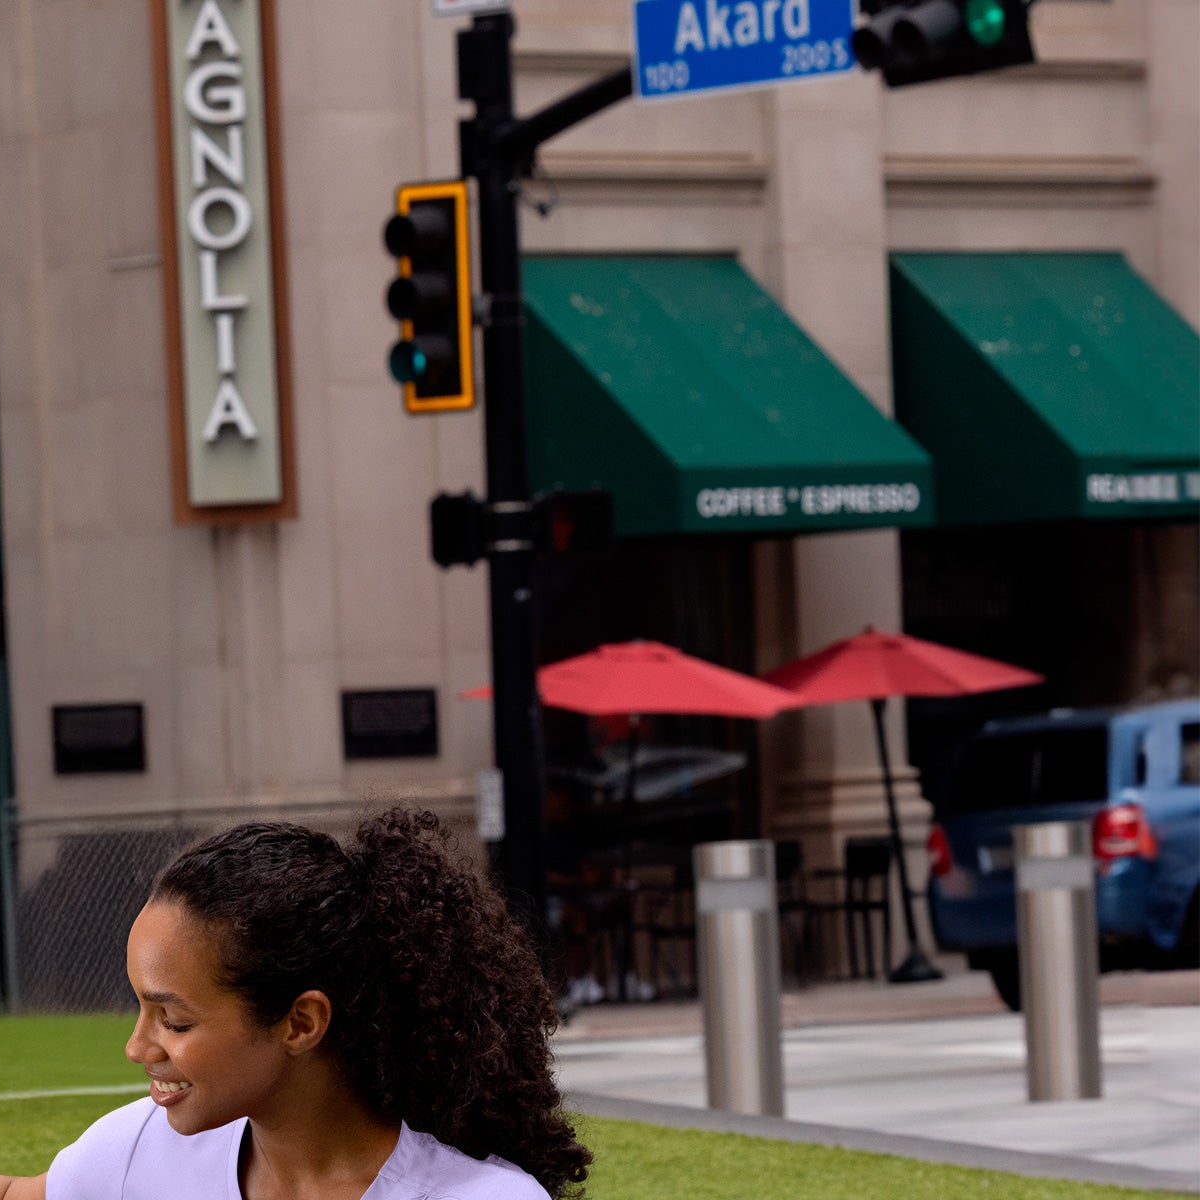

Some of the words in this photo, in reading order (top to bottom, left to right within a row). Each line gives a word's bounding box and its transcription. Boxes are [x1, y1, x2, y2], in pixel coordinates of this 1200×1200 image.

[675, 0, 810, 54] Akard
[646, 60, 689, 91] 100
[183, 0, 257, 441] AGNOLIA
[696, 486, 787, 519] COFFEE
[801, 482, 920, 514] ESPRESSO
